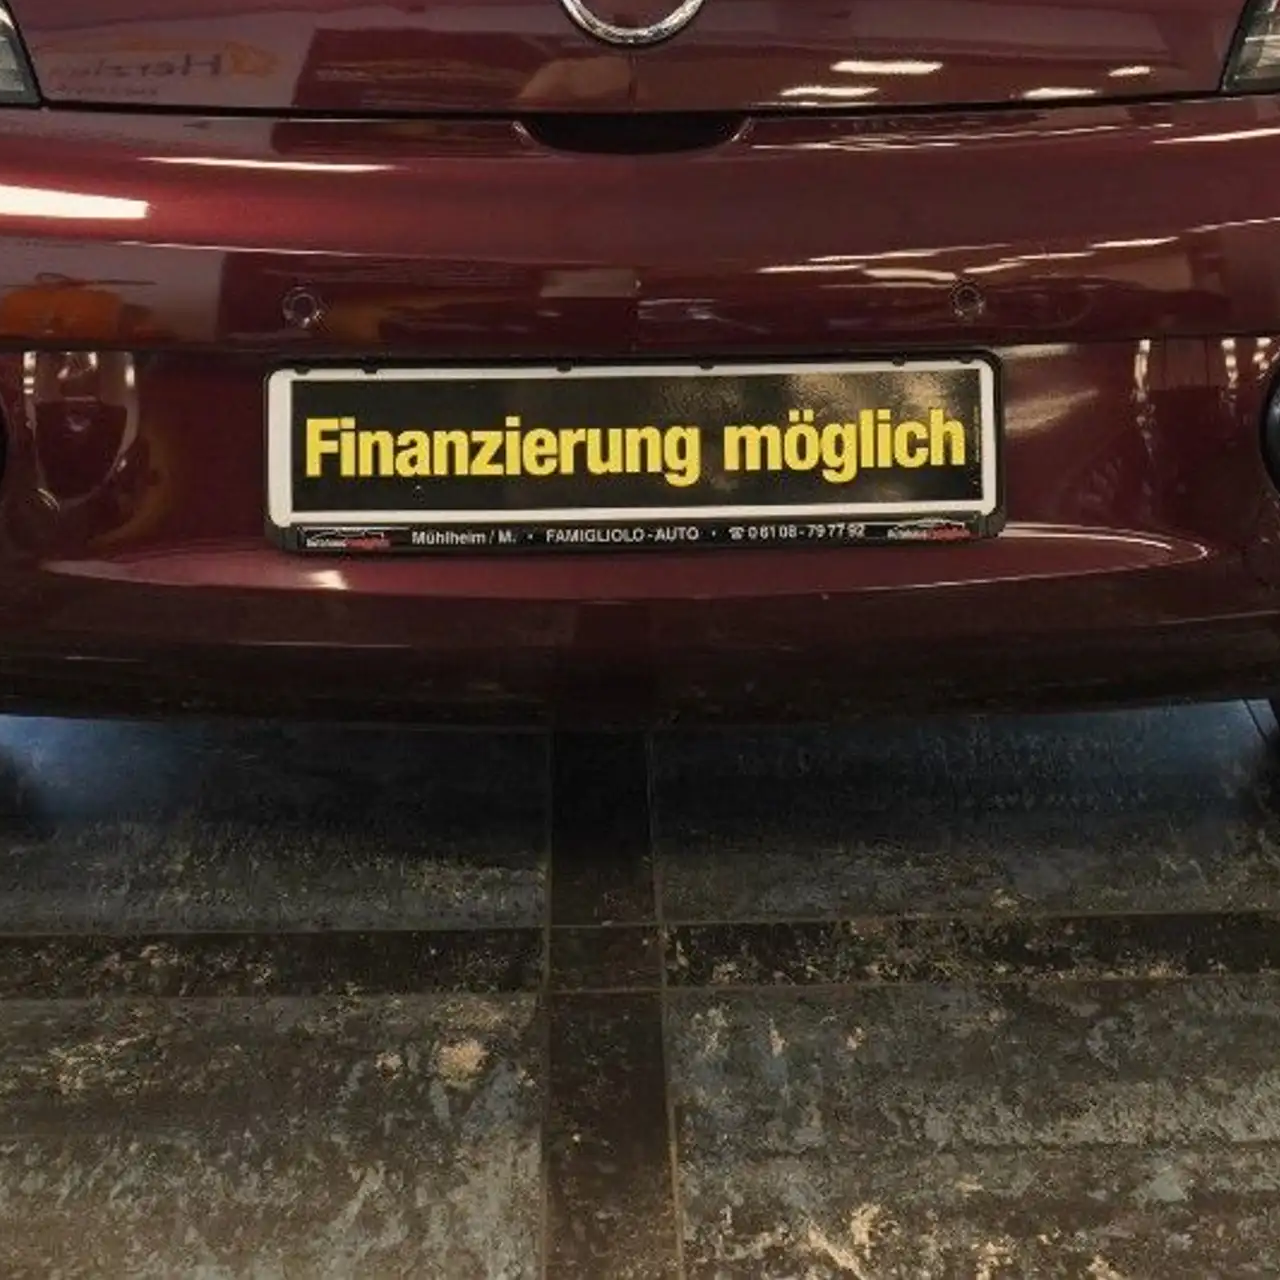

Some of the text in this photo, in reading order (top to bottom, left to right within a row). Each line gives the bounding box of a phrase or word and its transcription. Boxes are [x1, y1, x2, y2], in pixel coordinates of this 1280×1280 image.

[305, 416, 701, 487] Finanzierung
[723, 408, 966, 483] möglich
[411, 527, 486, 545] Mühlheim
